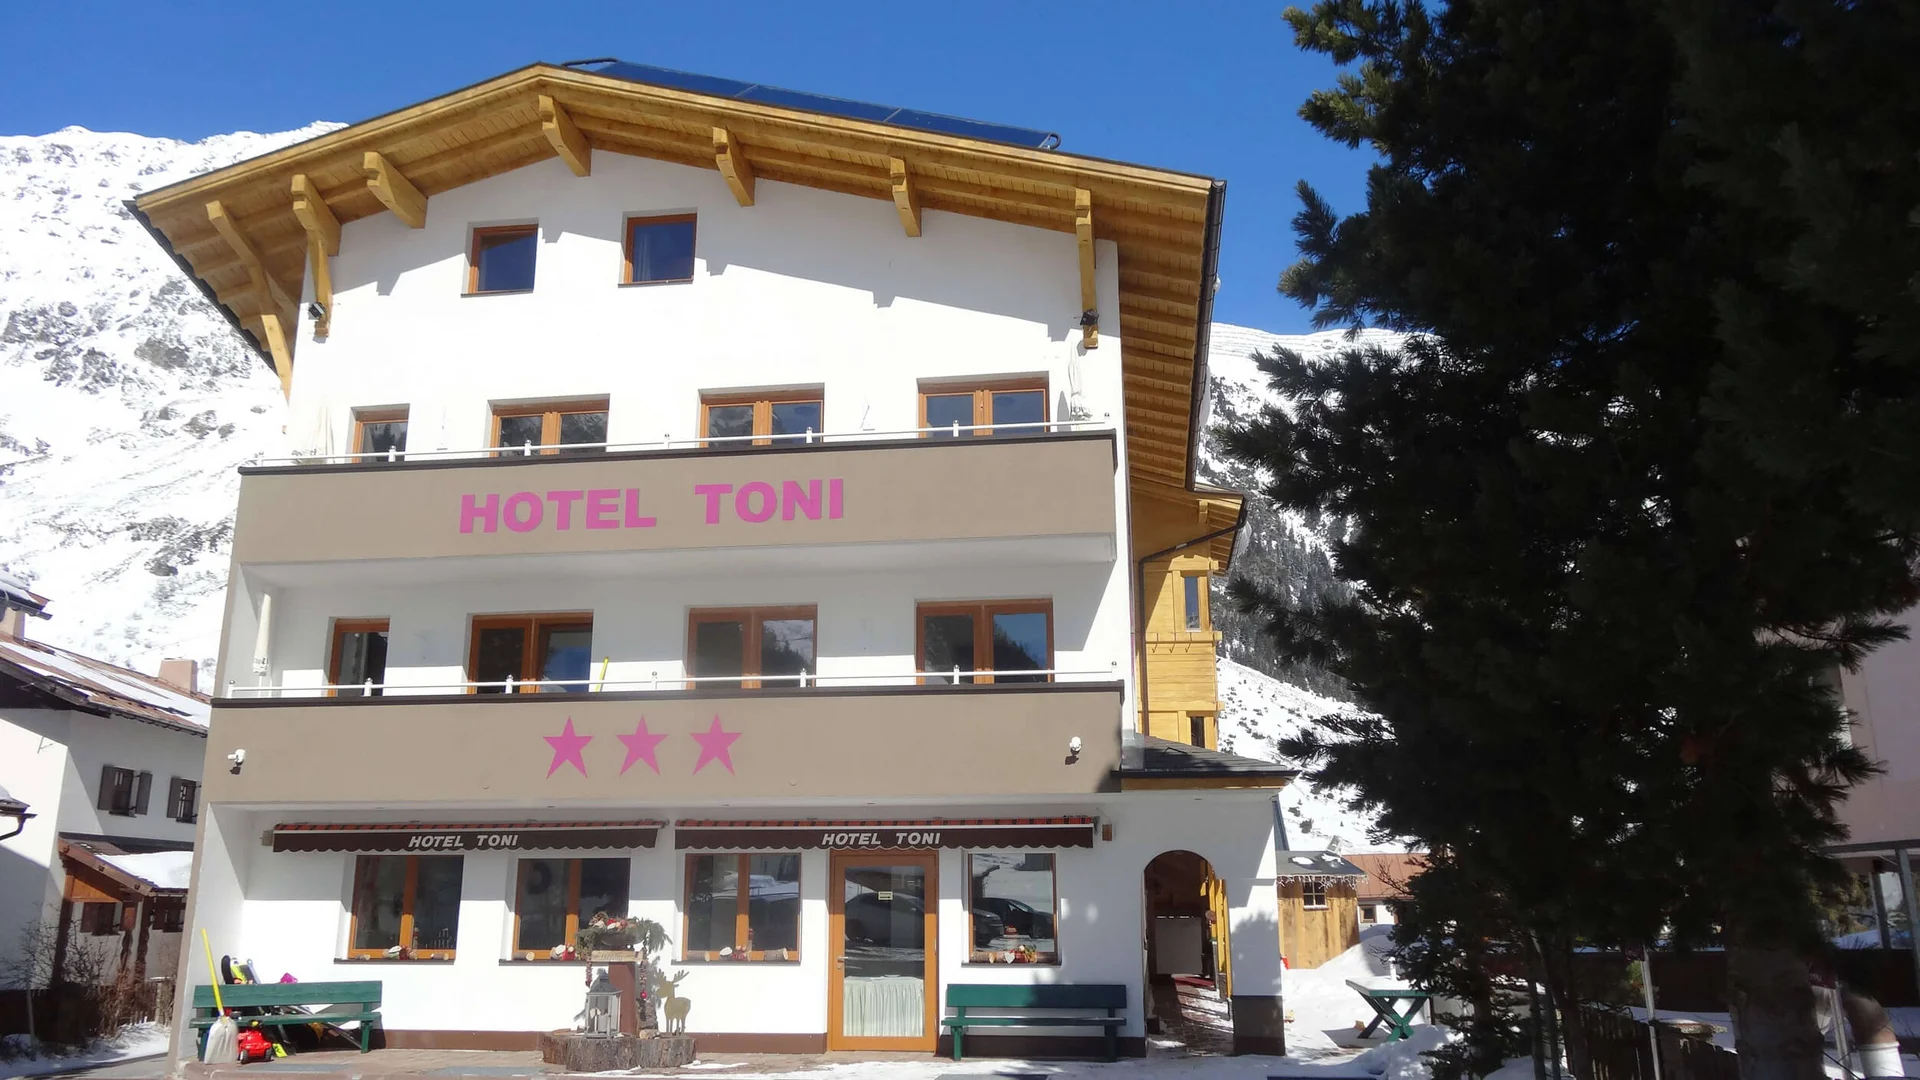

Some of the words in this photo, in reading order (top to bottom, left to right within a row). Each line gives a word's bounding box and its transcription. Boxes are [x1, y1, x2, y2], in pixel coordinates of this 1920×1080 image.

[460, 488, 656, 533] HOTEL
[695, 479, 844, 524] TONI
[408, 835, 464, 847] HOTEL
[477, 834, 519, 846] TONI
[821, 833, 881, 845] HOTEL
[896, 832, 940, 845] TONI
